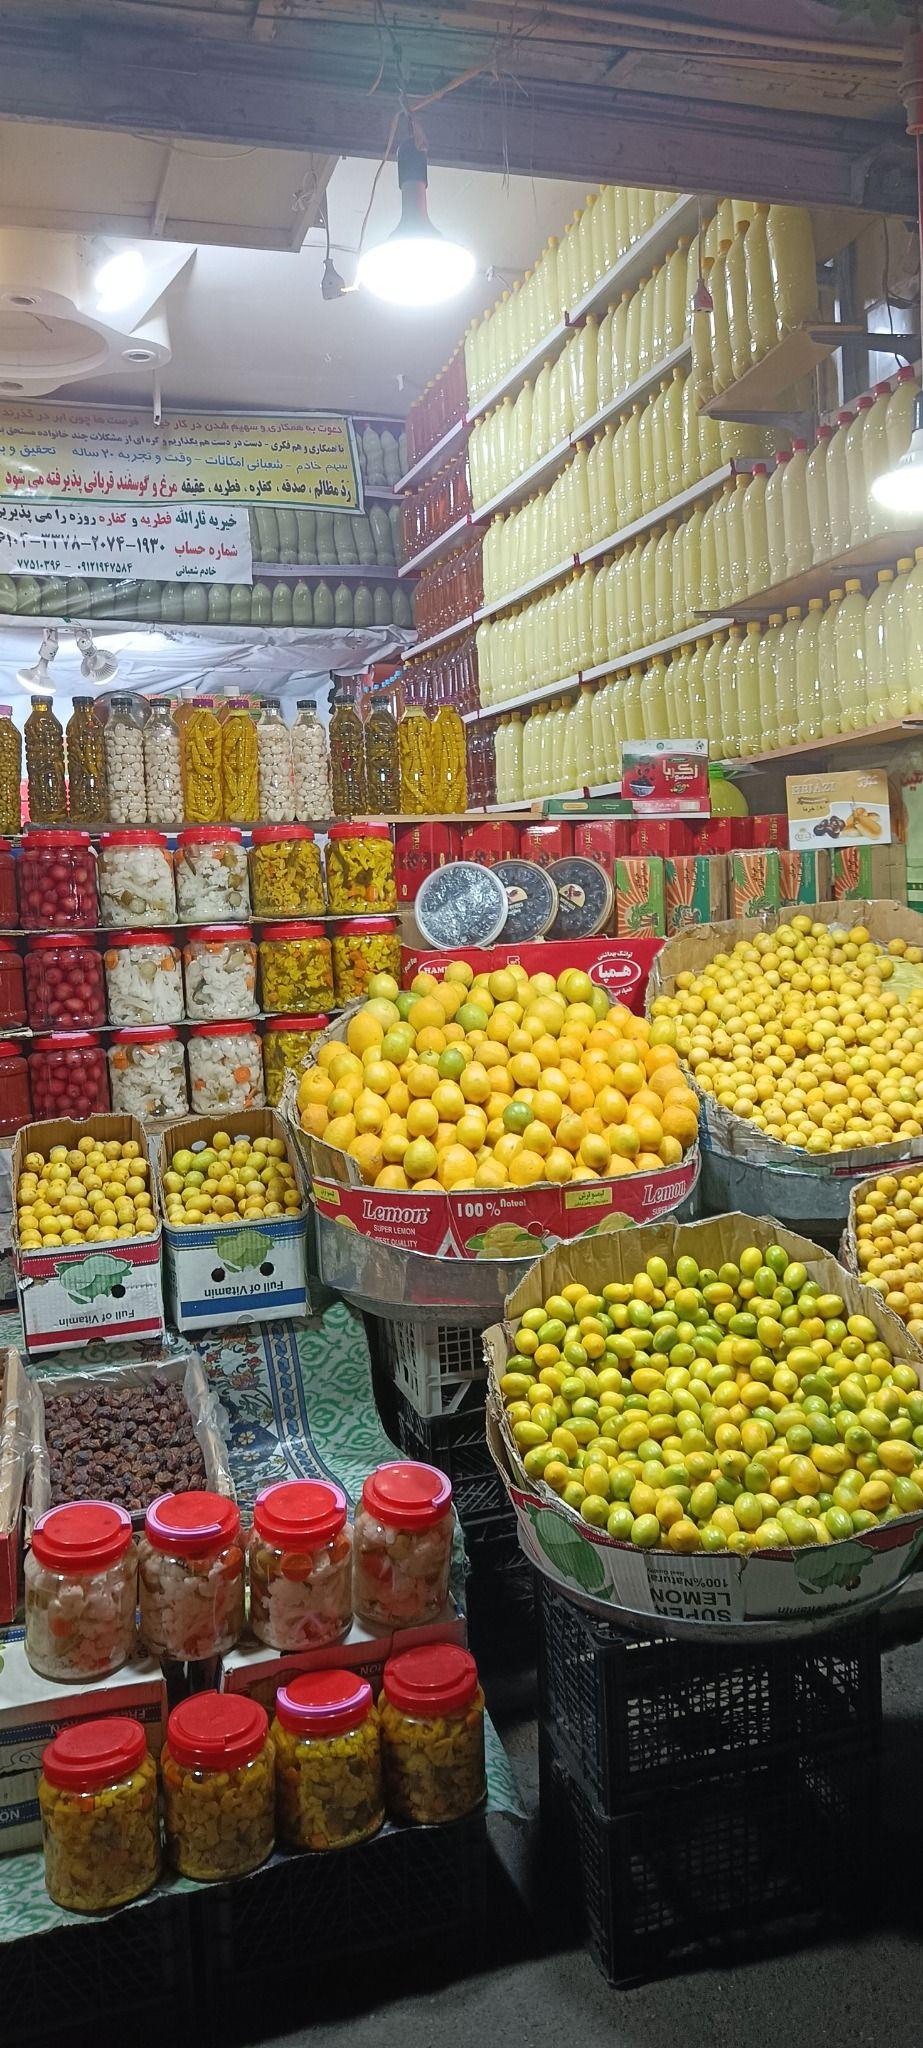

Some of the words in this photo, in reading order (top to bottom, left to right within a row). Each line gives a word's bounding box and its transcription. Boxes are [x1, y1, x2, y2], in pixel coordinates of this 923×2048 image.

[174, 419, 188, 431] کار
[190, 420, 202, 431] در
[205, 421, 229, 432] شدن
[266, 422, 304, 434] همکاری
[211, 439, 231, 447] دست
[234, 441, 243, 449] در
[244, 440, 263, 448] دست
[9, 446, 16, 456] و
[20, 445, 56, 457] تحقیق
[72, 447, 99, 458] ساله
[118, 451, 151, 463] تجربه
[155, 454, 161, 465] و
[165, 454, 192, 466] وقت
[205, 455, 244, 467] امکانات
[247, 458, 283, 472] شعبانی
[296, 461, 322, 474] خادم
[325, 463, 348, 474] سهم
[5, 468, 26, 491] شود
[28, 473, 44, 489] می
[47, 467, 82, 494] پذیرفته
[84, 469, 114, 495] قربانی
[117, 473, 150, 497] گوسفند
[159, 473, 178, 497] مرغ
[152, 480, 157, 497] و
[181, 477, 205, 497] عقیقه
[35, 512, 52, 523] می
[55, 509, 67, 524] را
[69, 512, 97, 525] روزه
[98, 512, 127, 526] کفاره
[131, 517, 138, 527] و
[140, 511, 172, 528] فطریه
[209, 513, 237, 531] خیریه
[174, 541, 206, 558] حساب
[208, 543, 238, 560] شماره
[175, 565, 199, 577] شعبانی
[199, 566, 217, 577] خادم
[598, 964, 632, 983] همپا
[642, 1180, 686, 1206] Lemon
[363, 1199, 430, 1224] Lemon
[373, 1224, 392, 1234] SUPER
[393, 1227, 416, 1236] LEMON
[204, 1284, 248, 1298] Vitamin
[250, 1282, 261, 1292] of
[263, 1280, 285, 1290] Full
[58, 1314, 99, 1327] Vitamin
[101, 1312, 112, 1320] of
[115, 1309, 135, 1320] Full
[649, 1587, 731, 1606] LEMON
